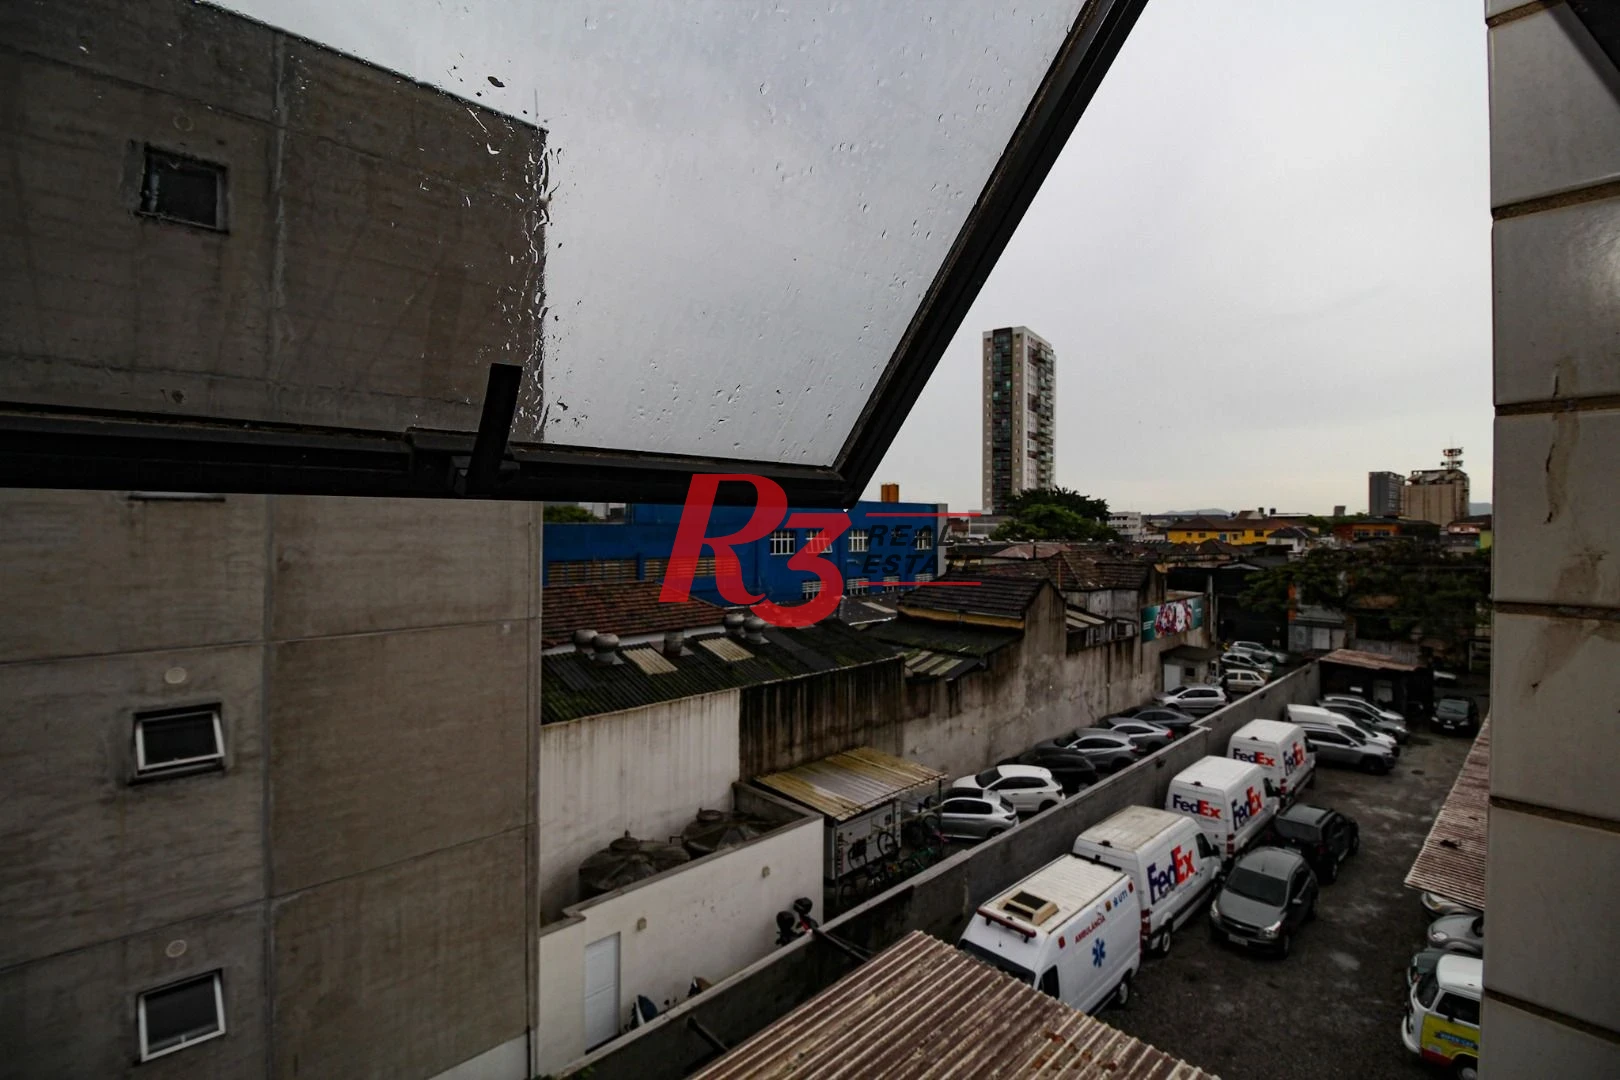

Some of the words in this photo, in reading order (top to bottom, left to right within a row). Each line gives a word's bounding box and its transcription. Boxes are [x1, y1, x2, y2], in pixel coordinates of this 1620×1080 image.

[1233, 748, 1275, 767] FedEx
[1283, 742, 1305, 776] FedEx
[1173, 794, 1222, 819] FedEx
[1231, 786, 1262, 831] FedEx
[1147, 845, 1196, 905] FedEx
